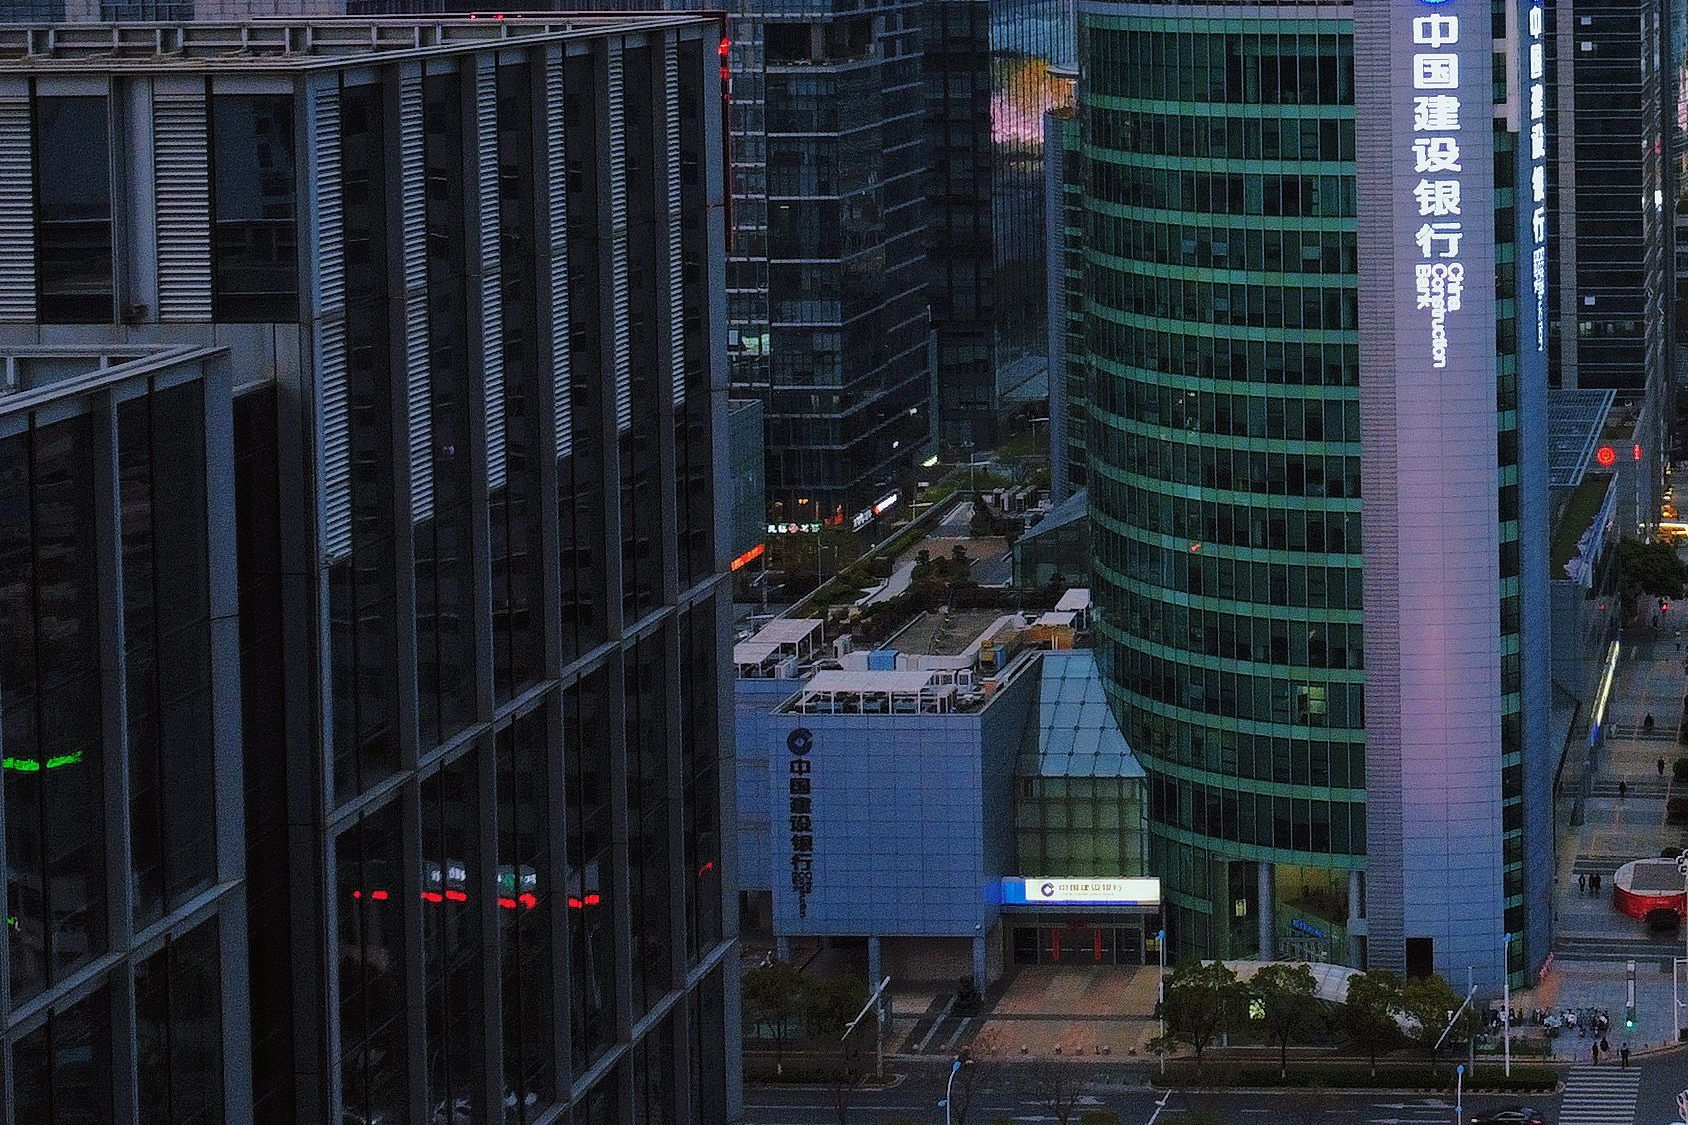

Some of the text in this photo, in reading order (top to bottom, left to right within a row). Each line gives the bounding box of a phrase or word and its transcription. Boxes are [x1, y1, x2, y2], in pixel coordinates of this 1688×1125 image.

[1412, 14, 1462, 257] 中国建设银行
[1415, 264, 1431, 310] Bank
[1431, 263, 1447, 368] Construction
[1447, 263, 1464, 311] China
